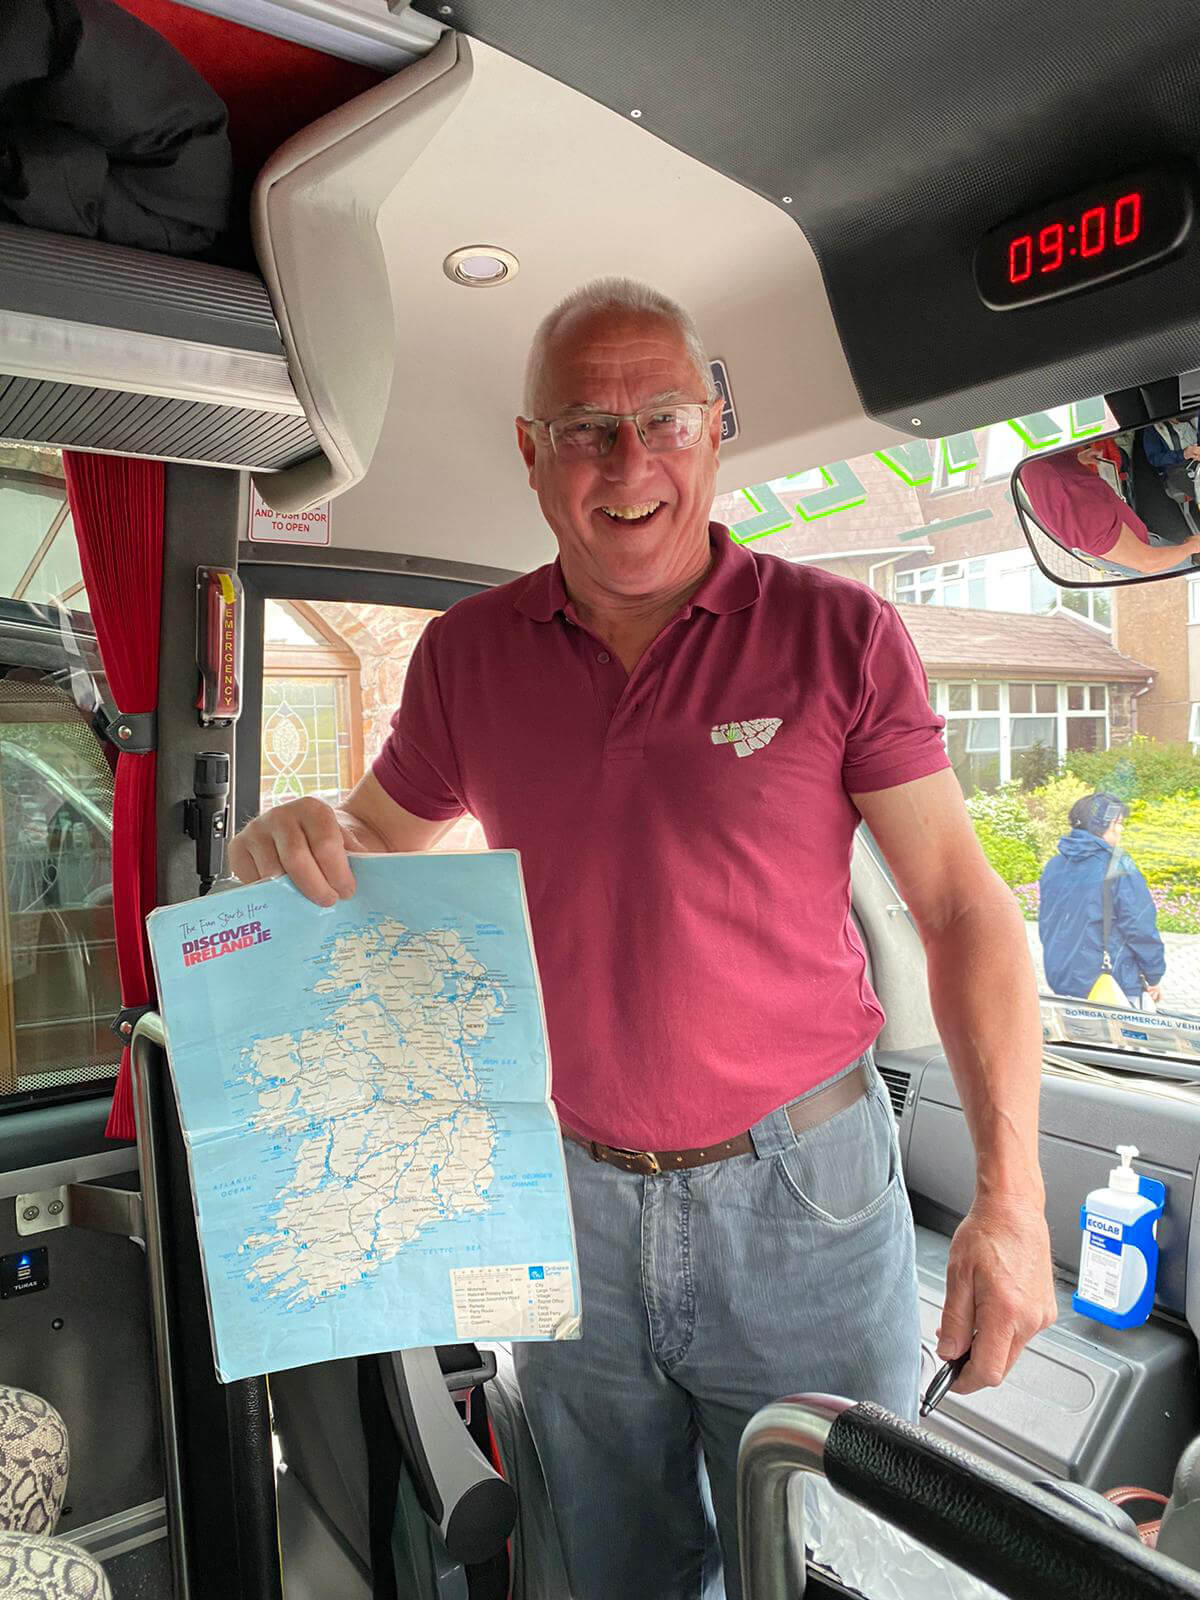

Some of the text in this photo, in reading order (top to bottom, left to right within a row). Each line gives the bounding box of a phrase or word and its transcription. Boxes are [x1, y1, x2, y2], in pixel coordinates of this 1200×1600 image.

[1009, 193, 1141, 283] 09:00
[255, 508, 273, 518] AND
[301, 512, 327, 522] DOOR
[272, 521, 310, 532] TO OPEN
[224, 608, 234, 706] EMERGENCY
[179, 903, 269, 940] The Fun Starts Here
[182, 920, 262, 955] DISCOVER
[183, 928, 272, 968] IRELAND.IE
[1064, 1008, 1108, 1020] DONEGAL
[1110, 1012, 1173, 1028] COMMERCIAL
[1087, 1218, 1120, 1236] ECOLAB
